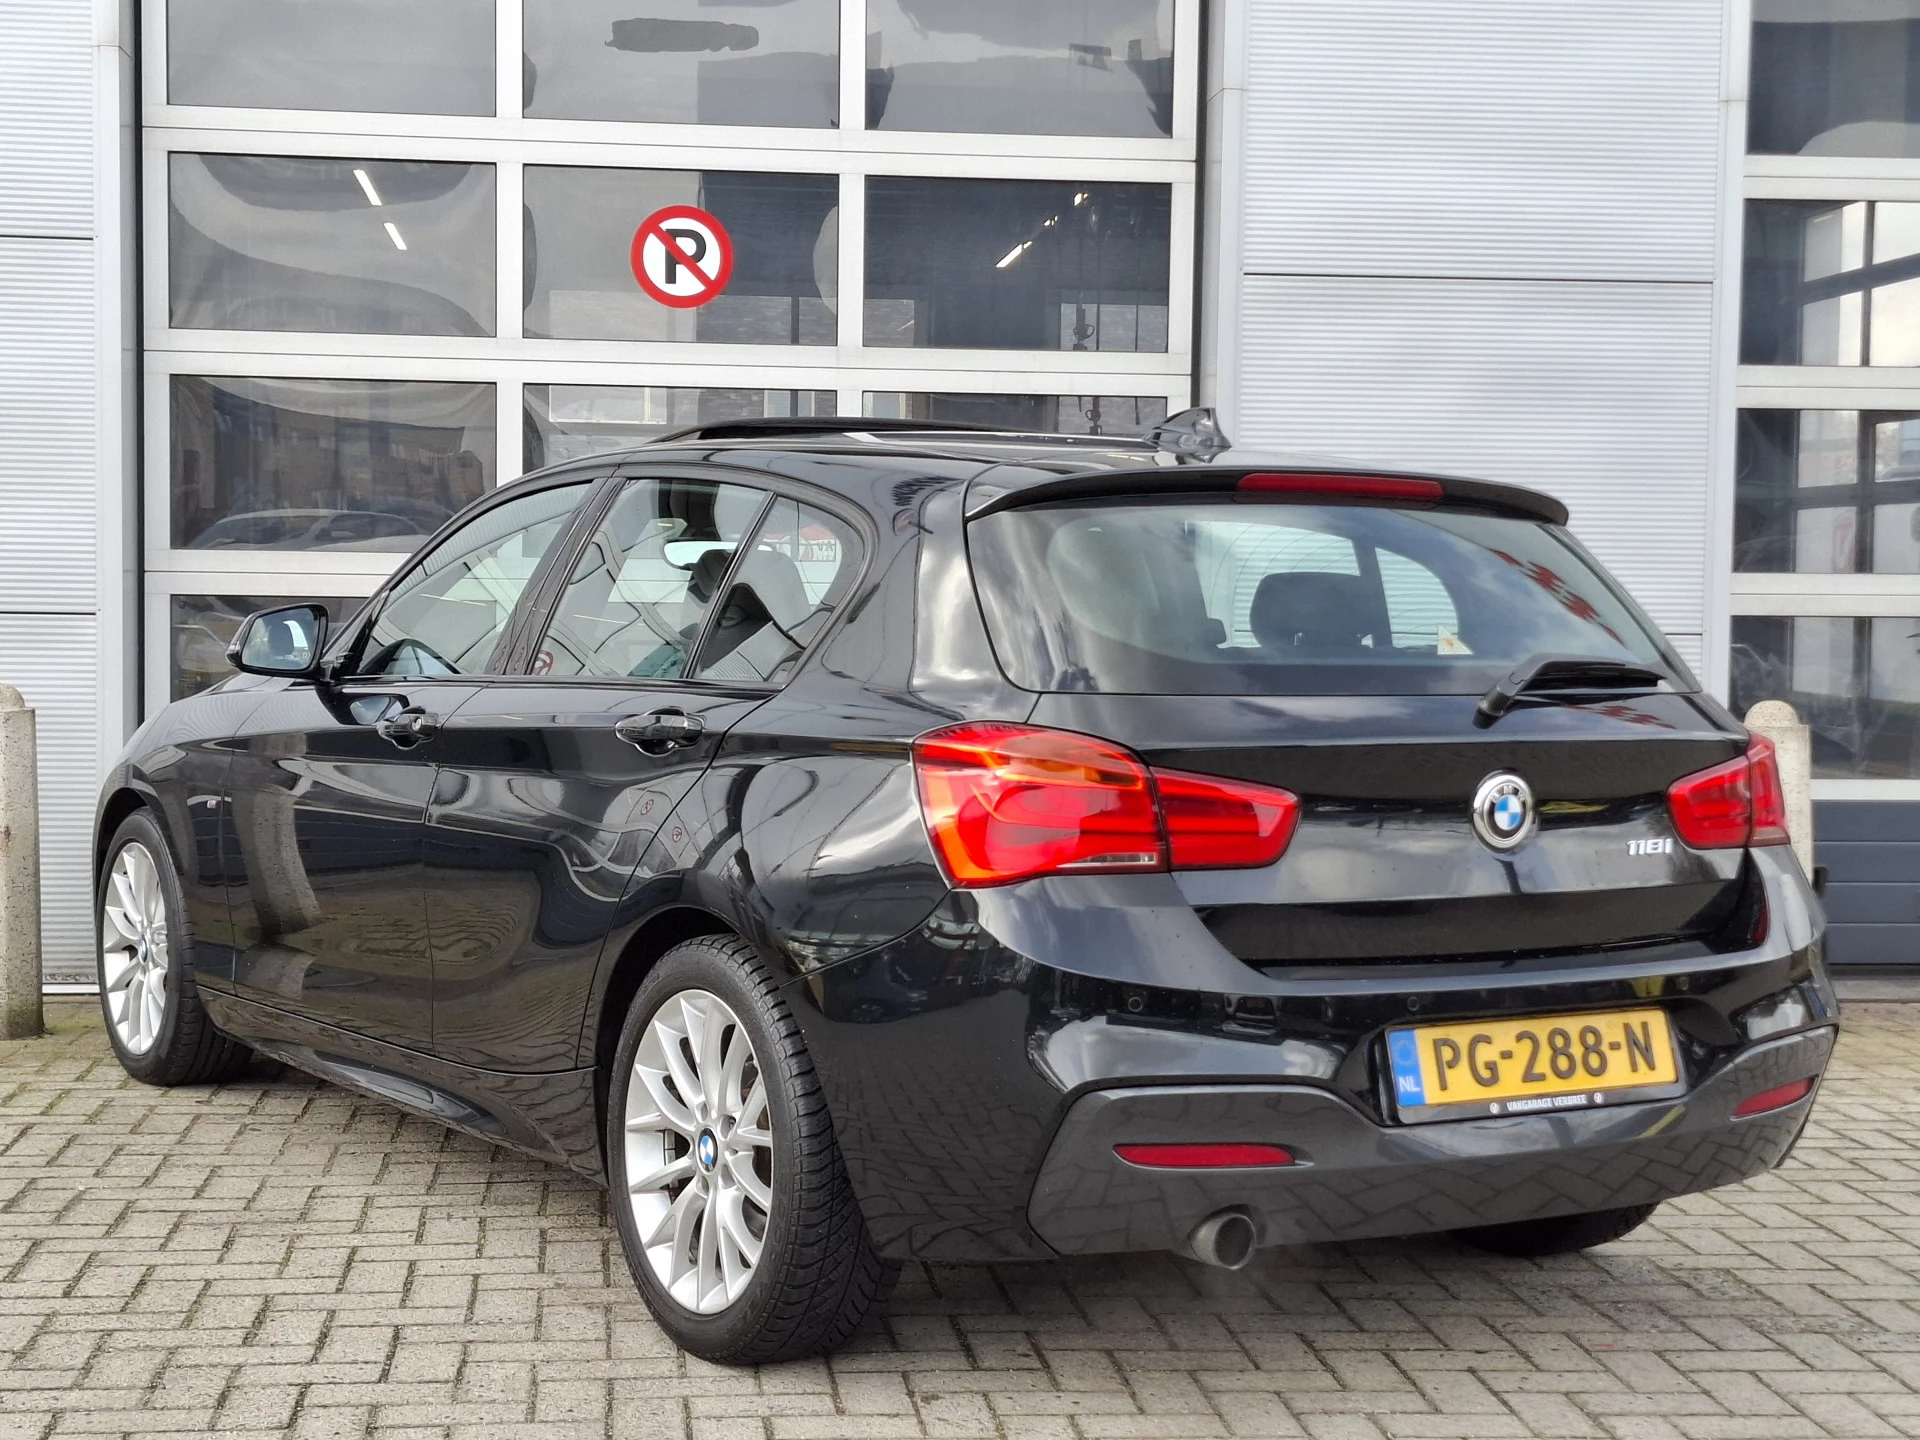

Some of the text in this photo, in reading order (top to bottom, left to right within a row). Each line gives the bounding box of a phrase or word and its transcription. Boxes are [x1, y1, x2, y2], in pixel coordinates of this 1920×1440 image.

[664, 228, 707, 285] P
[1626, 837, 1673, 856] 118i
[1432, 1021, 1657, 1091] PG-288-N
[1399, 1076, 1421, 1093] NL
[1552, 1093, 1588, 1107] VERBREE
